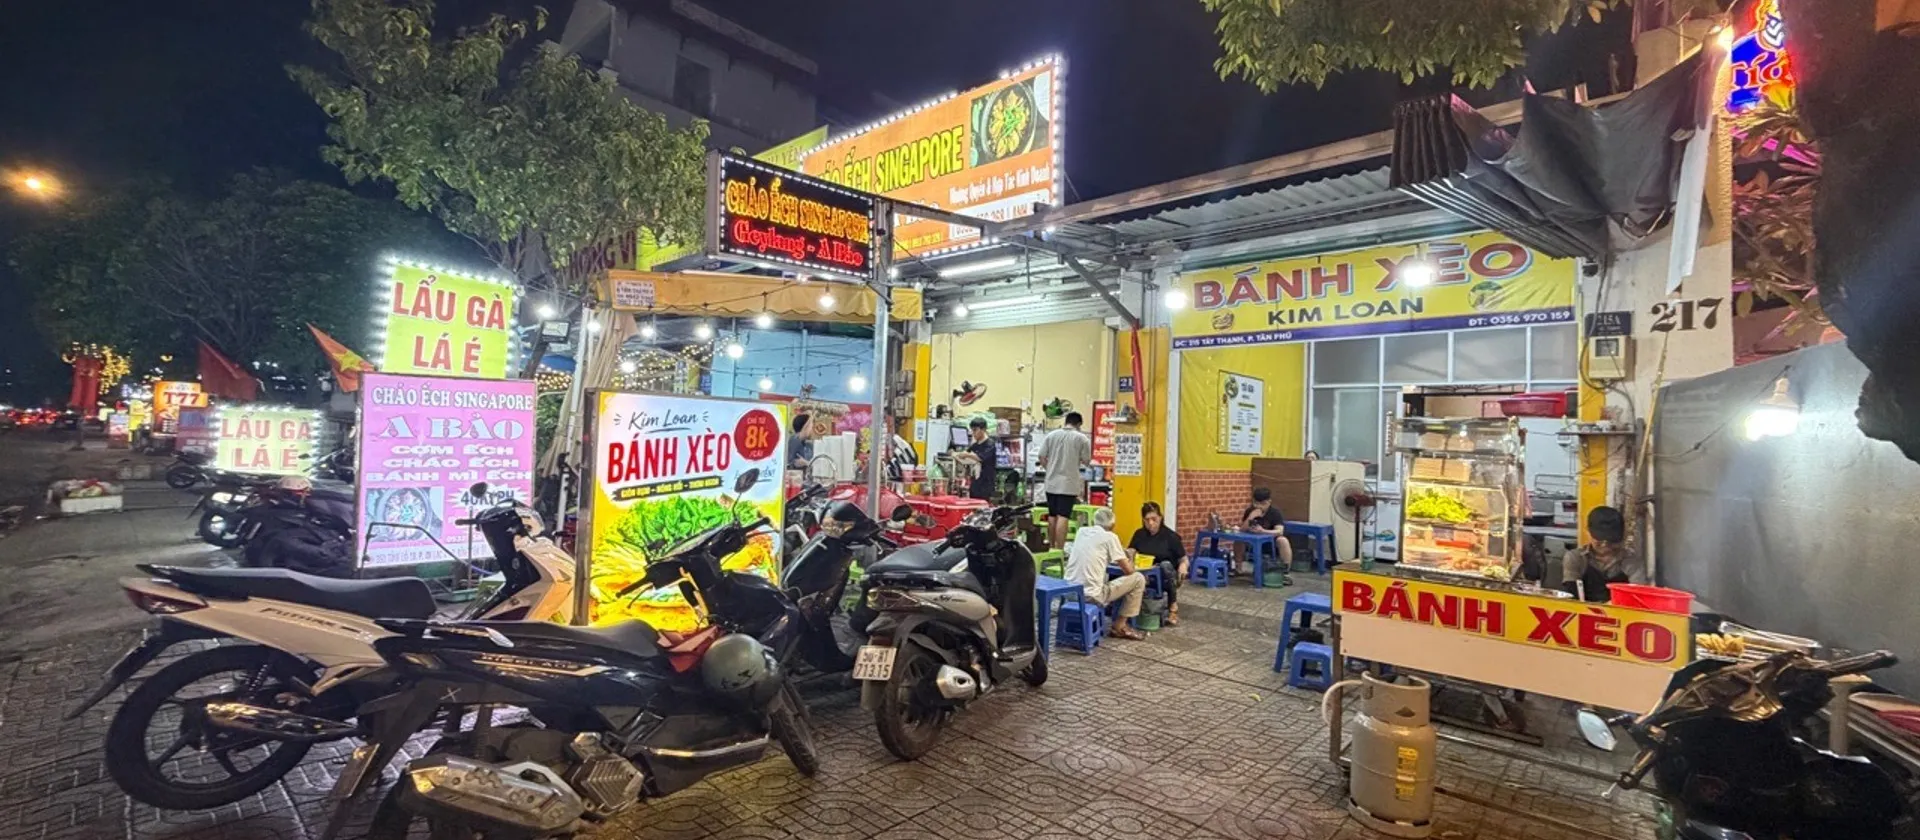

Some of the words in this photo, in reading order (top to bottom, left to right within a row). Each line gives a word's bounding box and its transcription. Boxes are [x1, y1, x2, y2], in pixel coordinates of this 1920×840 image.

[874, 124, 964, 196] SINGAPORE
[769, 177, 799, 228] ẾCH
[800, 199, 869, 244] SINGAPORE
[1193, 262, 1354, 311] BÁNH
[1374, 241, 1534, 293] XÈO
[392, 274, 457, 322] LẨU
[466, 292, 505, 330] GÀ
[1268, 306, 1322, 326] KIM
[1334, 297, 1423, 321] LOAN
[1649, 296, 1725, 334] 217
[1490, 315, 1520, 325] 0356
[1523, 313, 1548, 322] 970
[1550, 310, 1571, 320] 159
[413, 332, 452, 370] LÁ
[462, 336, 481, 373] É
[163, 392, 199, 405] T77
[420, 381, 451, 407] ẾCH
[454, 391, 534, 411] SINGAPORE
[221, 411, 271, 440] LẨU
[279, 416, 312, 440] GÀ
[628, 412, 659, 430] Kim
[662, 409, 699, 428] Loan
[234, 444, 271, 468] LÁ
[282, 443, 299, 468] É
[463, 443, 514, 456] ẾCH
[469, 456, 520, 468] ẾCH
[607, 432, 679, 484] BÁNH
[685, 427, 732, 475] XÈO
[366, 469, 440, 481] BÁNH
[486, 469, 532, 481] ẾCH
[1341, 580, 1505, 637] BÁNH
[1526, 605, 1676, 663] XÈO
